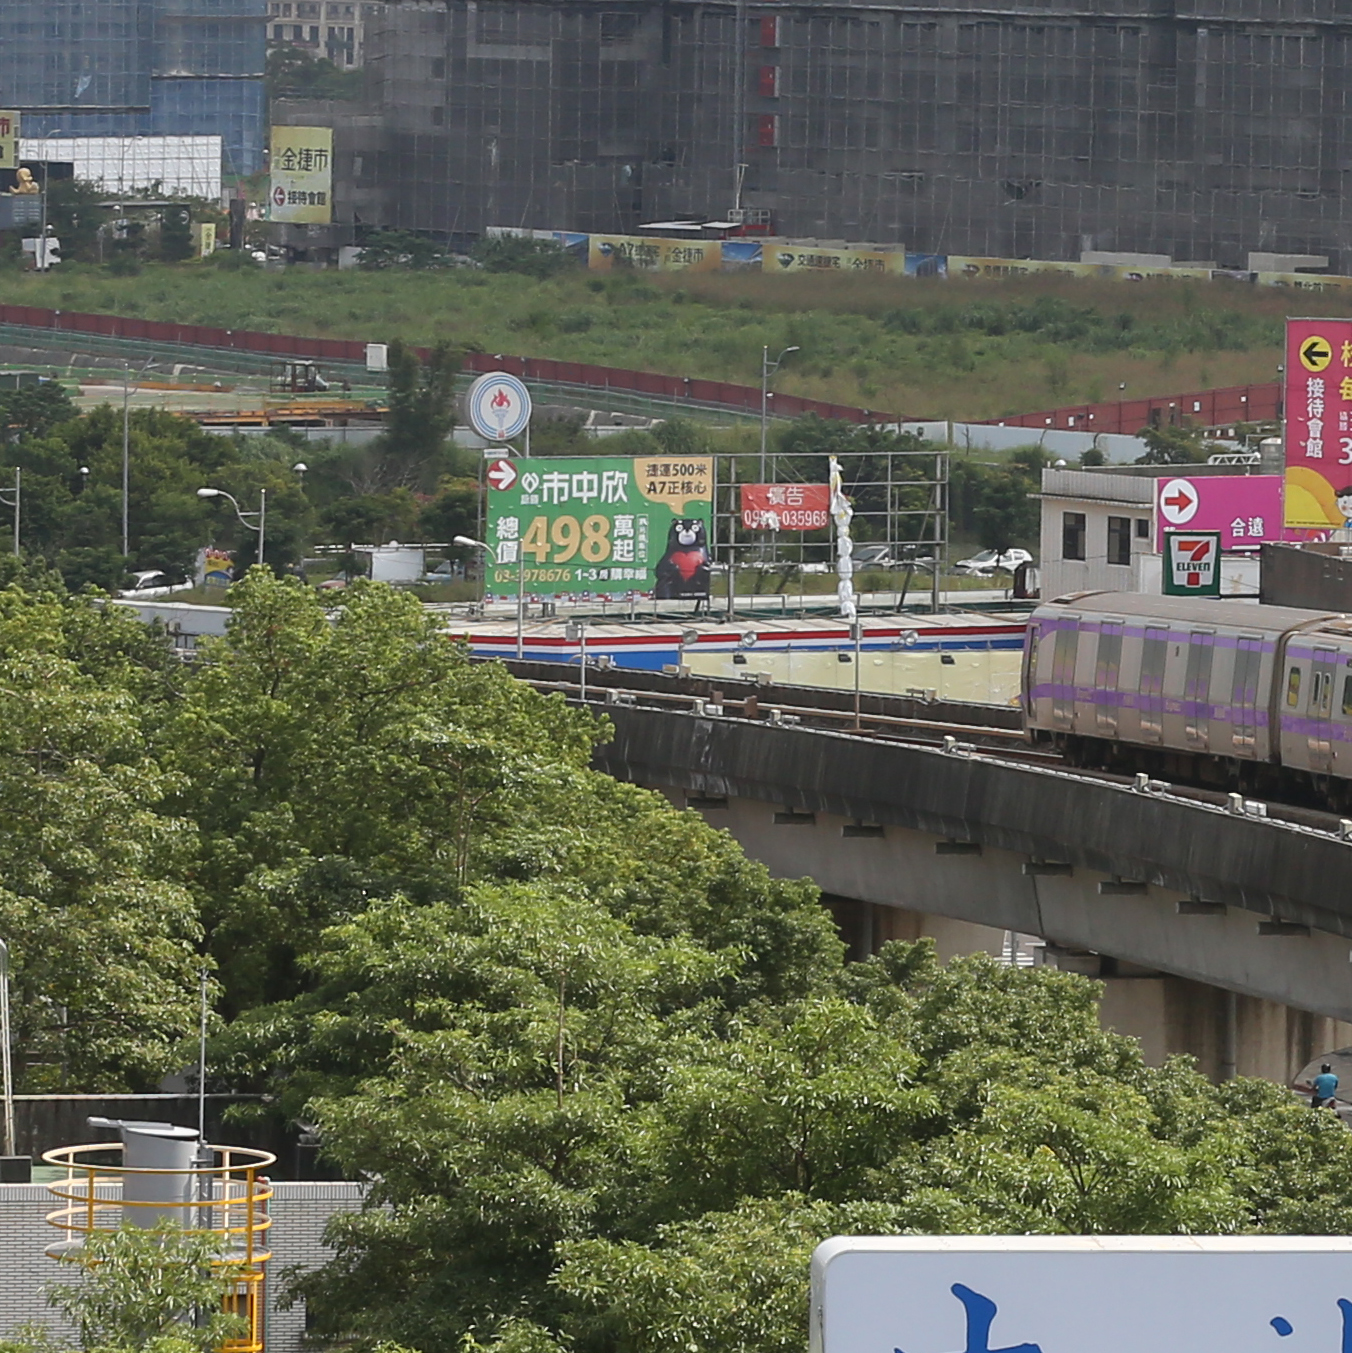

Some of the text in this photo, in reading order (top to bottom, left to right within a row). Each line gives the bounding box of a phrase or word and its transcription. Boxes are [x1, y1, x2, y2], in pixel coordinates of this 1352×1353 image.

[281, 147, 329, 172] 金捷市
[1305, 377, 1325, 459] 接待會館
[541, 470, 628, 504] 市中欣
[646, 463, 708, 478] 捷運500米
[646, 480, 708, 496] A7正核心
[769, 485, 804, 506] 廣告
[496, 516, 520, 564] 總價
[521, 514, 612, 564] 498
[611, 514, 636, 563] 萬起
